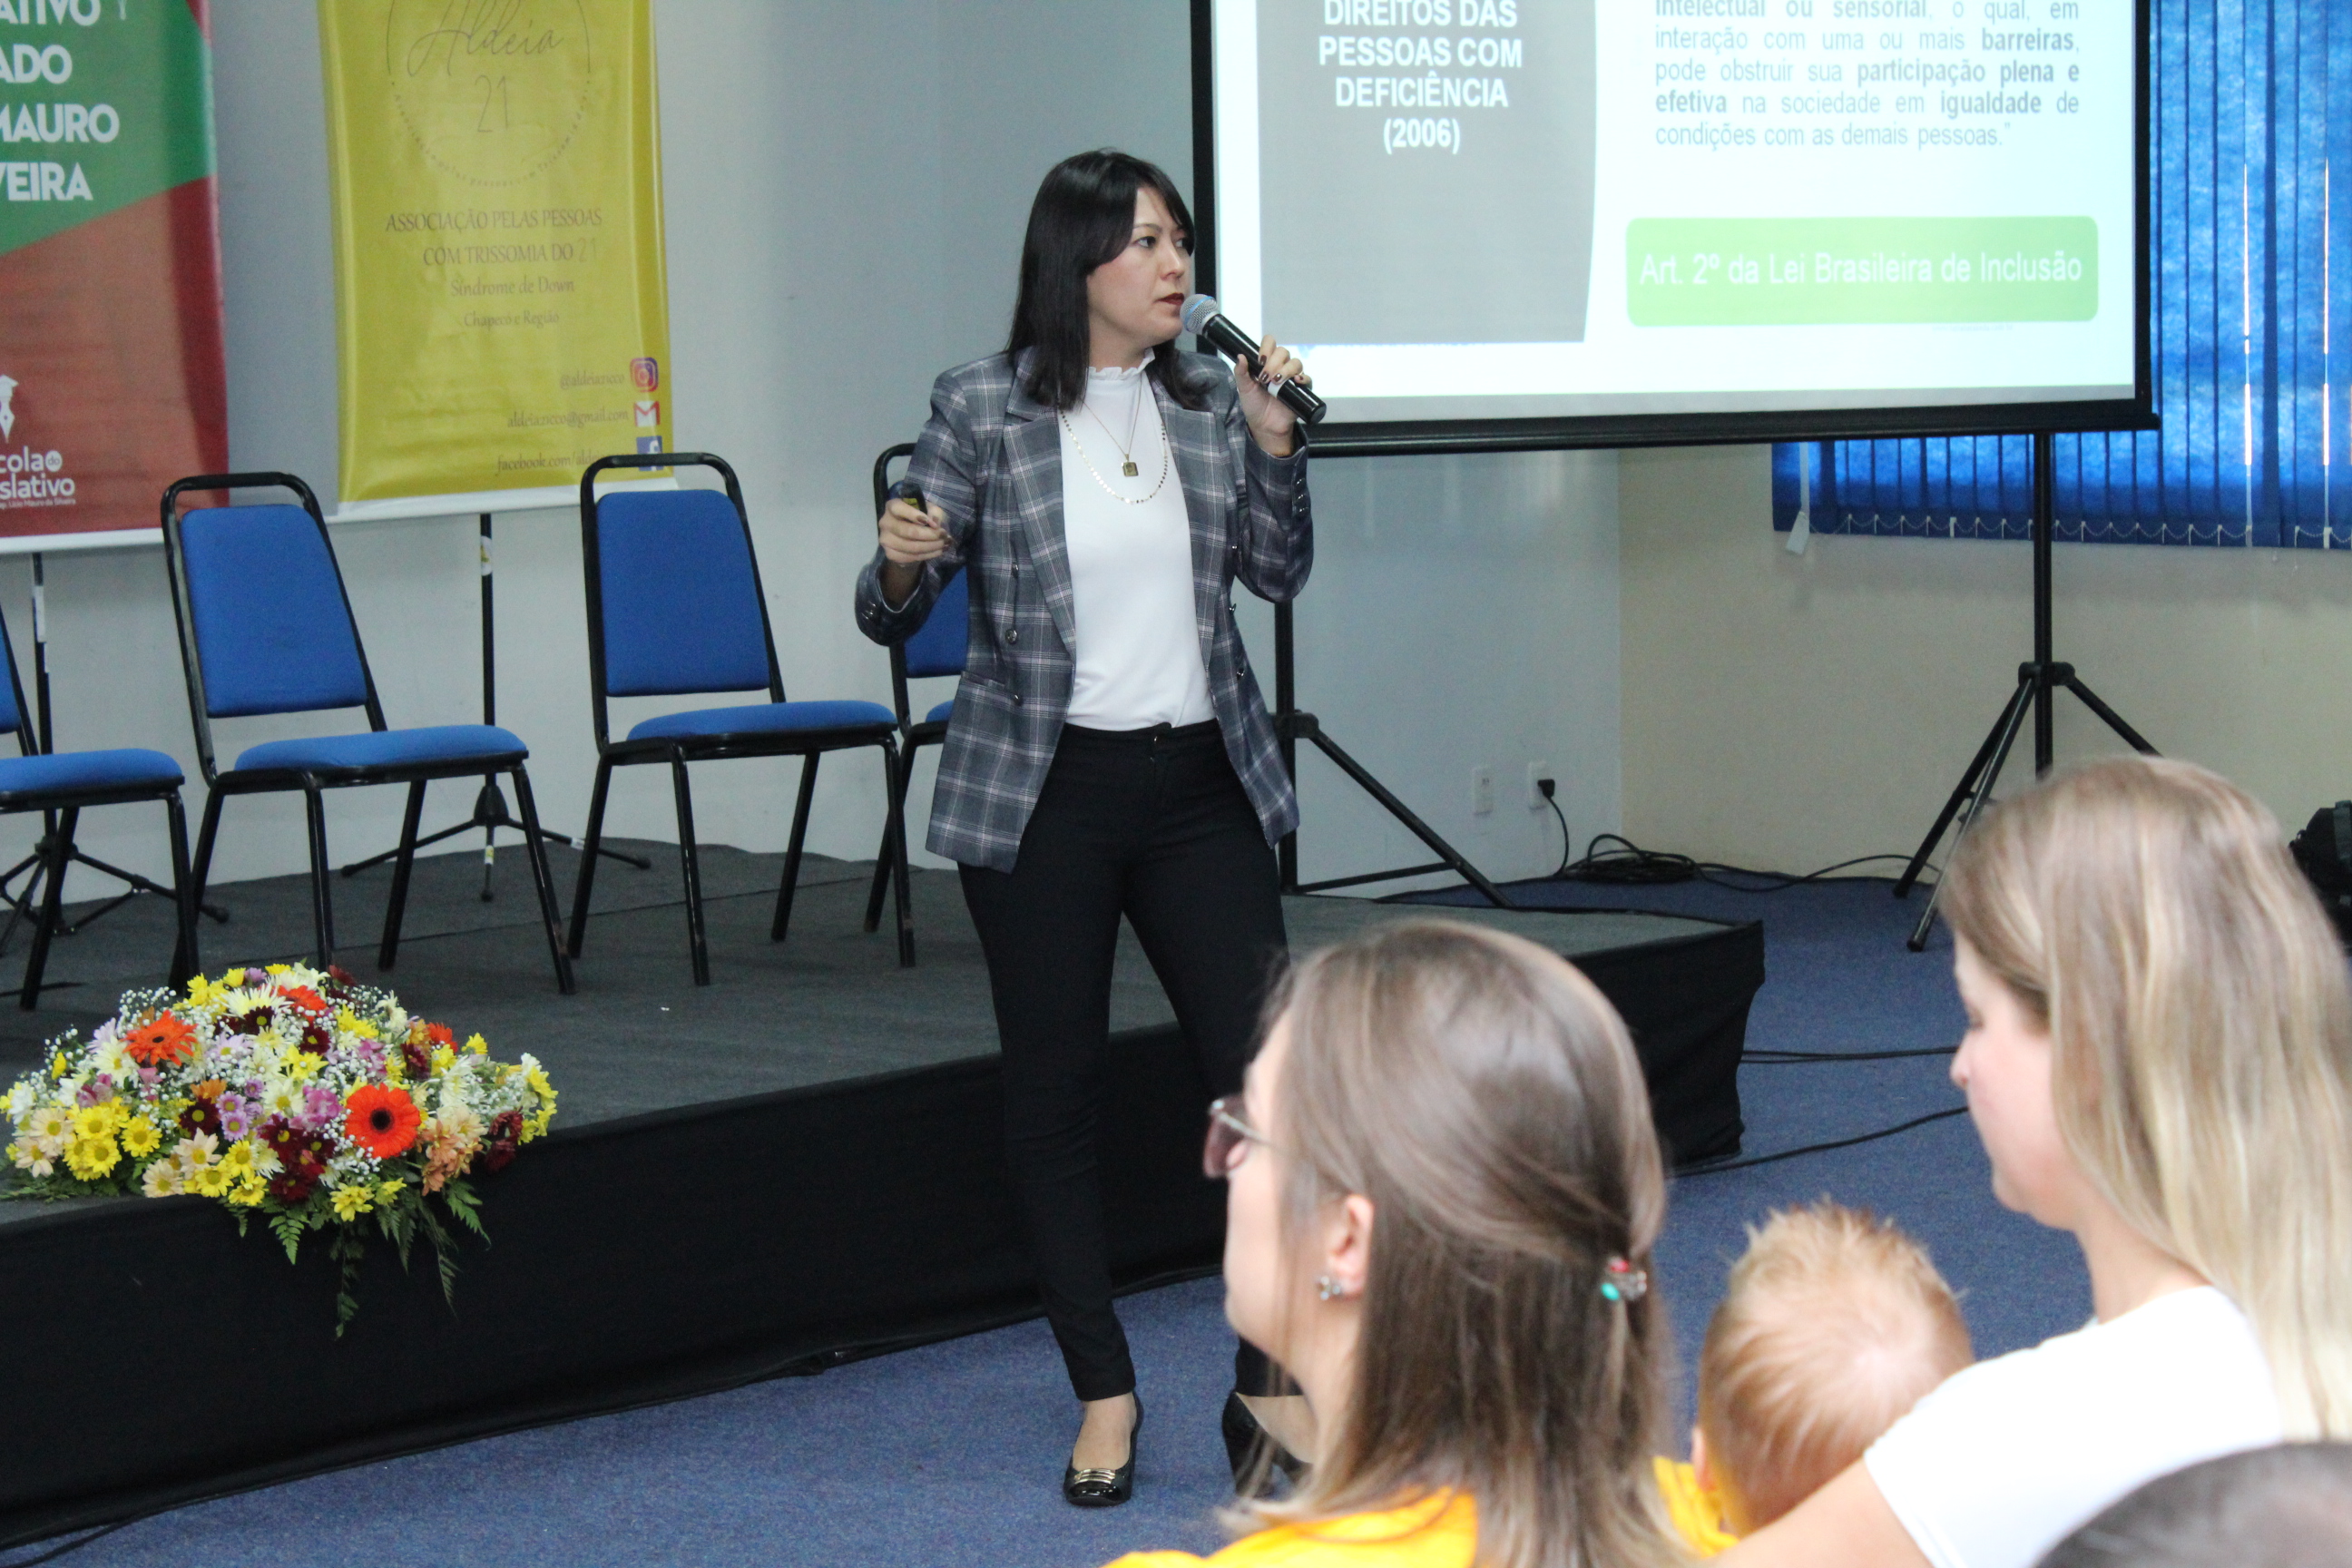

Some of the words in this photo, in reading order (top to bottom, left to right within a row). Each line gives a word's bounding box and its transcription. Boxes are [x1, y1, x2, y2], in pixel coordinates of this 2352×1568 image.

[1324, 0, 1452, 25] DIREITOS
[1459, 0, 1518, 27] DAS
[1655, 0, 1766, 16] intelectual
[1786, 1, 1813, 18] ou
[1833, 0, 1933, 20] sensorial,
[1952, 2, 1964, 19] o
[1984, 0, 2030, 25] qual,
[2050, 2, 2079, 19] em
[407, 0, 565, 77] Aldeia
[1318, 36, 1452, 66] PESSOAS
[1457, 37, 1523, 68] COM
[1655, 24, 1748, 55] interação
[1764, 32, 1806, 49] com
[1822, 33, 1864, 50] uma
[1879, 33, 1903, 50] ou
[1919, 26, 1965, 50] mais
[1982, 27, 2080, 54] barreiras,
[1656, 57, 1706, 86] pode
[1720, 58, 1794, 82] obstruir
[1808, 64, 1842, 82] sua
[1857, 58, 1985, 88] participação
[2001, 60, 2053, 88] plena
[2068, 64, 2080, 83] e
[474, 74, 510, 133] 21
[1336, 70, 1509, 107] DEFICIÊNCIA
[1656, 89, 1727, 113] efetiva
[1742, 94, 1766, 113] na
[1781, 90, 1880, 113] sociedade
[1896, 95, 1925, 113] em
[1941, 91, 2042, 120] igualdade
[2056, 91, 2079, 113] de
[1383, 118, 1461, 155] (2006)
[1656, 122, 1756, 152] condições
[1764, 128, 1804, 145] com
[1812, 128, 1834, 145] as
[1842, 122, 1908, 145] demais
[385, 209, 488, 233] ASSOCIAÇÃO
[492, 210, 539, 230] PELAS
[543, 208, 603, 228] PESSOAS
[423, 245, 462, 266] COM
[464, 244, 547, 264] TRISSOMIA
[552, 242, 574, 261] DO
[577, 237, 598, 263] 21
[1640, 253, 1683, 285] Art.
[1692, 252, 1720, 285] 2º
[1729, 253, 1759, 284] da
[1769, 253, 1805, 284] Lei
[1815, 251, 1933, 283] Brasileira
[1940, 252, 1971, 283] de
[1981, 250, 2082, 282] Inclusão
[450, 274, 516, 297] Síndrome
[519, 274, 534, 294] de
[537, 275, 575, 294] Down
[524, 309, 560, 329] Região
[48, 454, 61, 466] do
